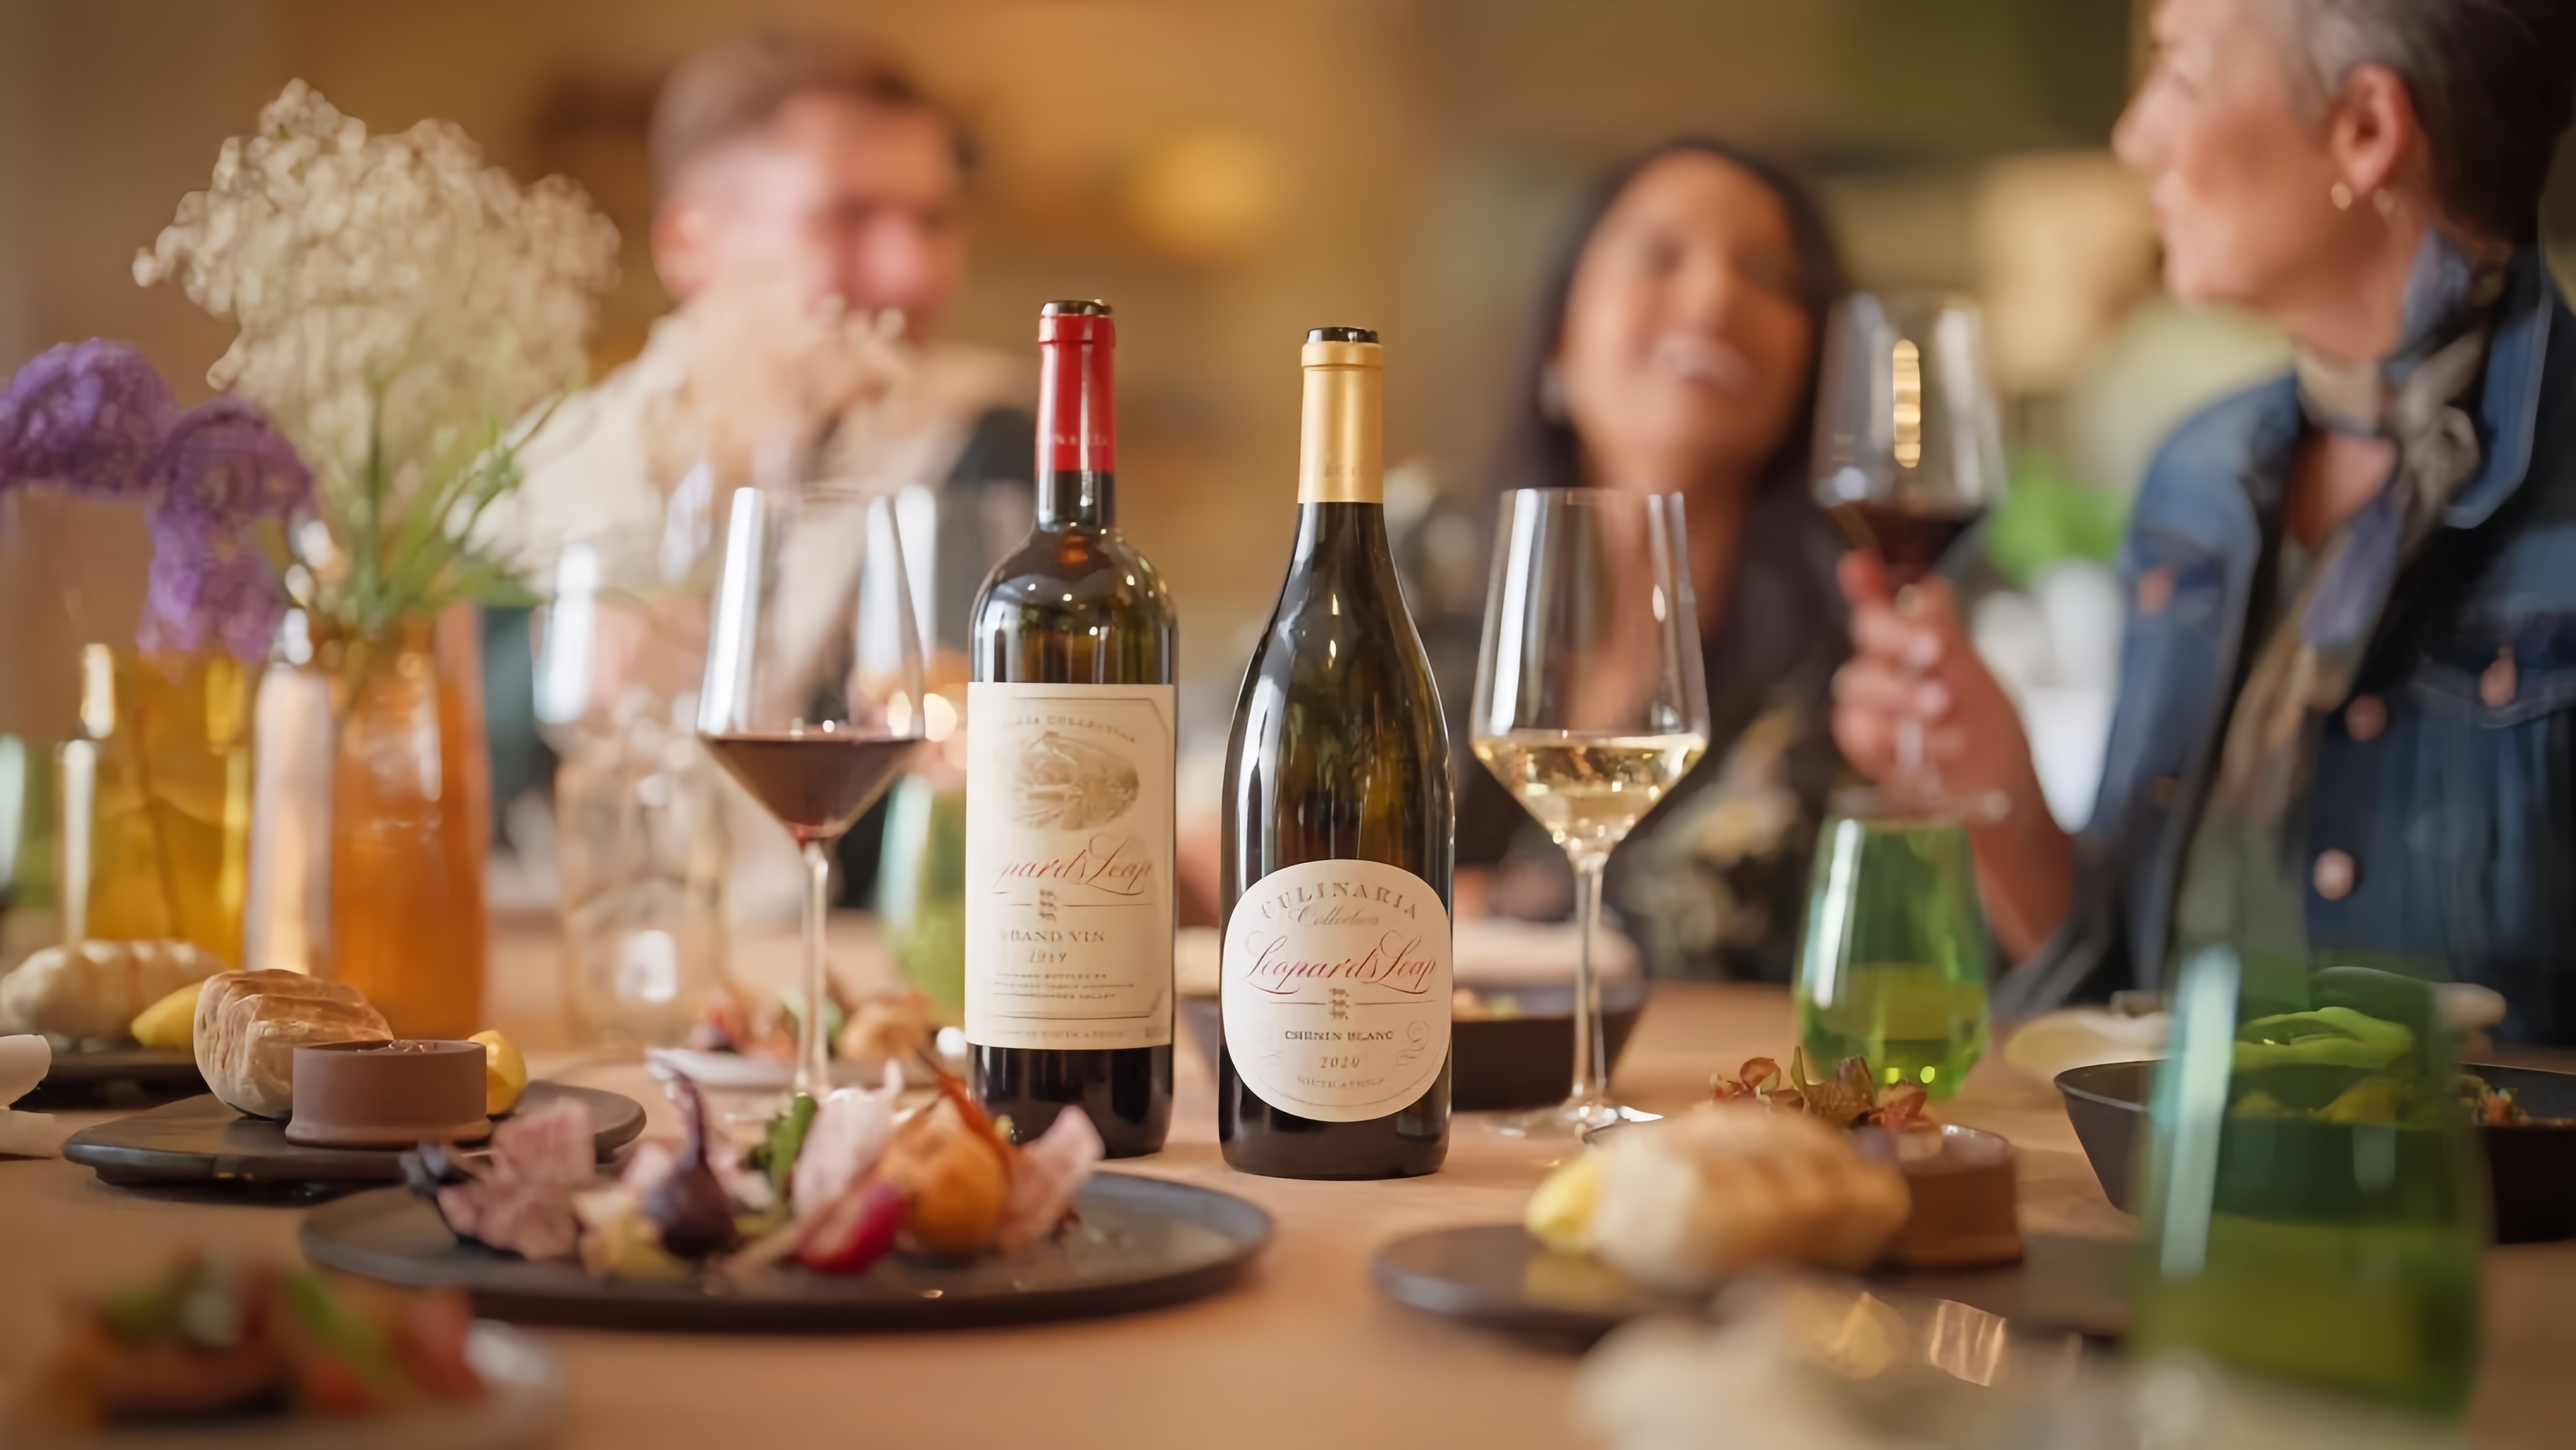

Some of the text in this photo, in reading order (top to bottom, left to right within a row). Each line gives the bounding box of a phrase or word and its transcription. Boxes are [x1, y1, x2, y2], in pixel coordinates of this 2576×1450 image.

[1261, 882, 1416, 920] CULINARIA
[1004, 930, 1063, 941] RAND
[1284, 1030, 1394, 1041] CHENIN BLANC
[1320, 1055, 1360, 1069] 2020
